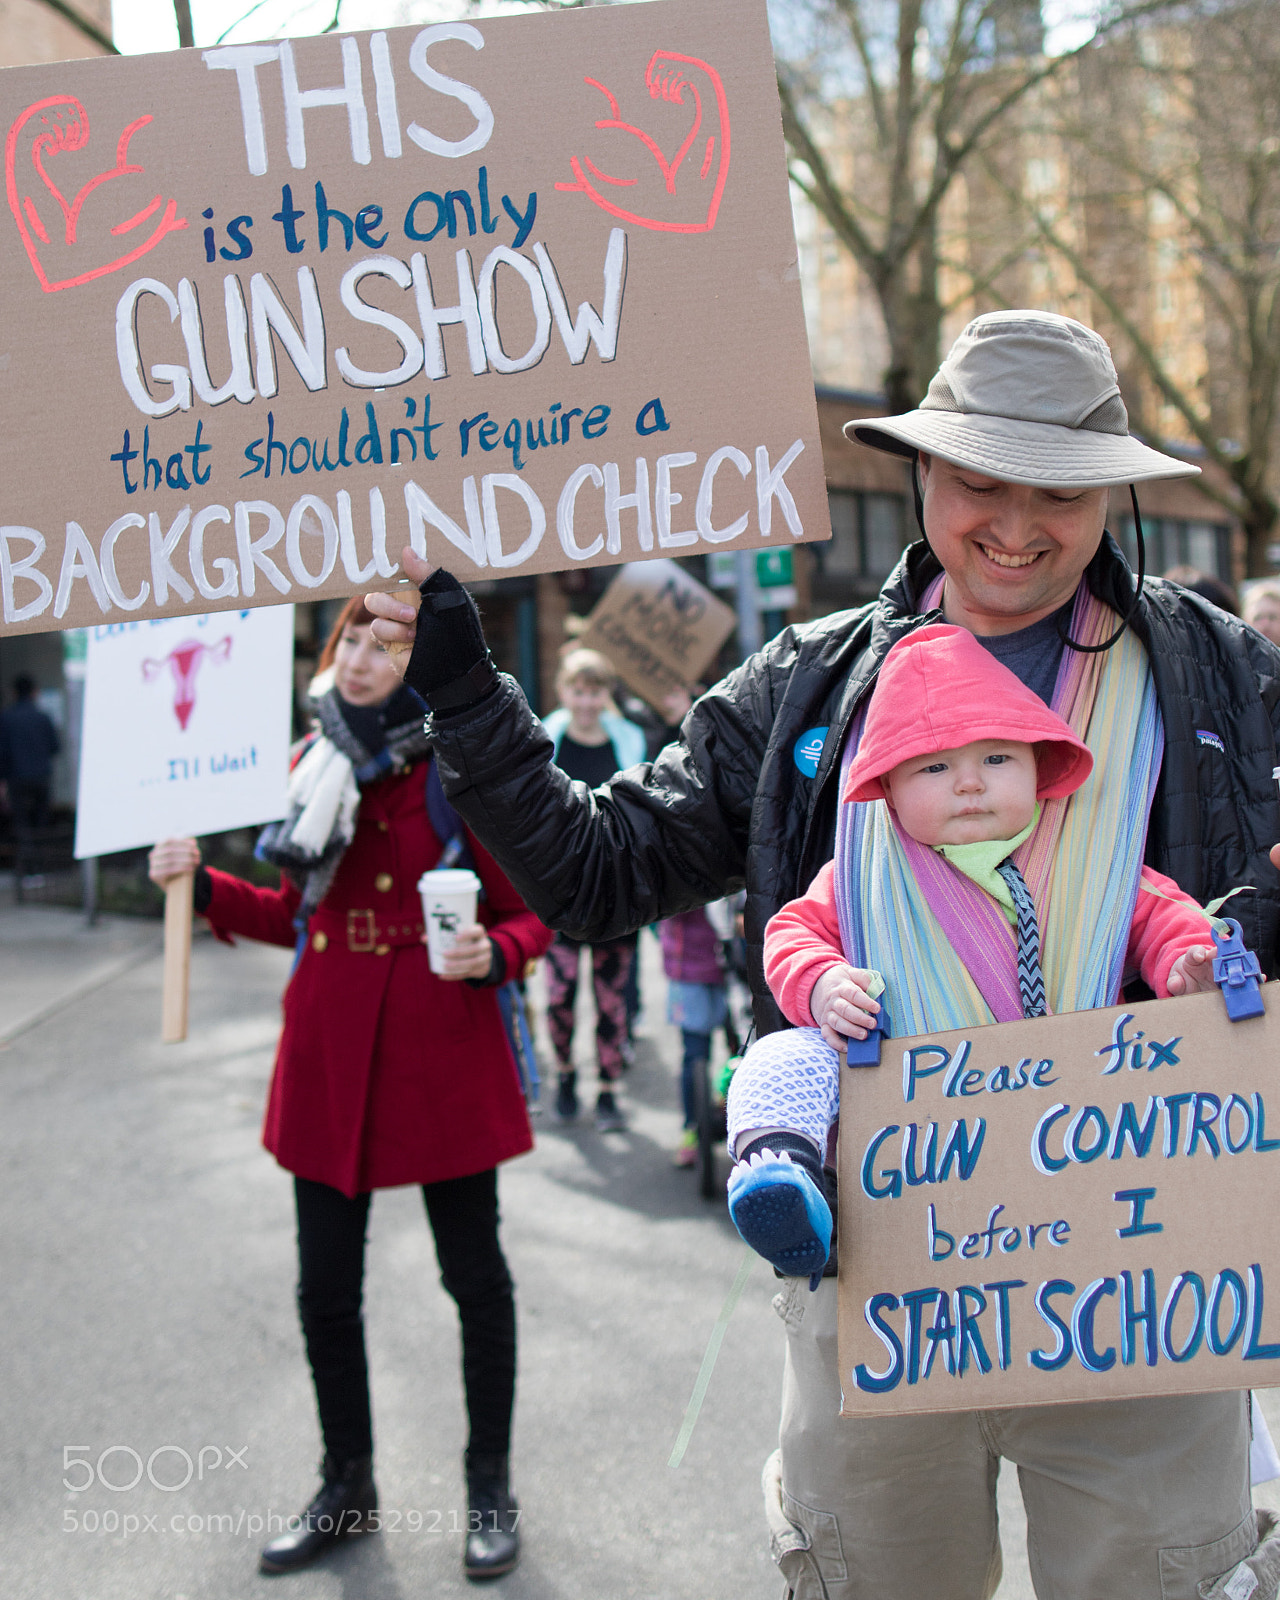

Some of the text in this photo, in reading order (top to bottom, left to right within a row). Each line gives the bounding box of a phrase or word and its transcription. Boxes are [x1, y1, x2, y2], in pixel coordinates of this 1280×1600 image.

[202, 22, 494, 176] THIS
[204, 166, 538, 263] is the only
[110, 394, 671, 494] that shouldn't require a
[0, 439, 806, 624] BACKGROUND CHECK
[902, 1013, 1184, 1102] Please fix
[860, 1091, 1280, 1200] GUN CONTROL
[928, 1187, 1164, 1261] before I
[852, 1262, 1280, 1393] START SCHOOL
